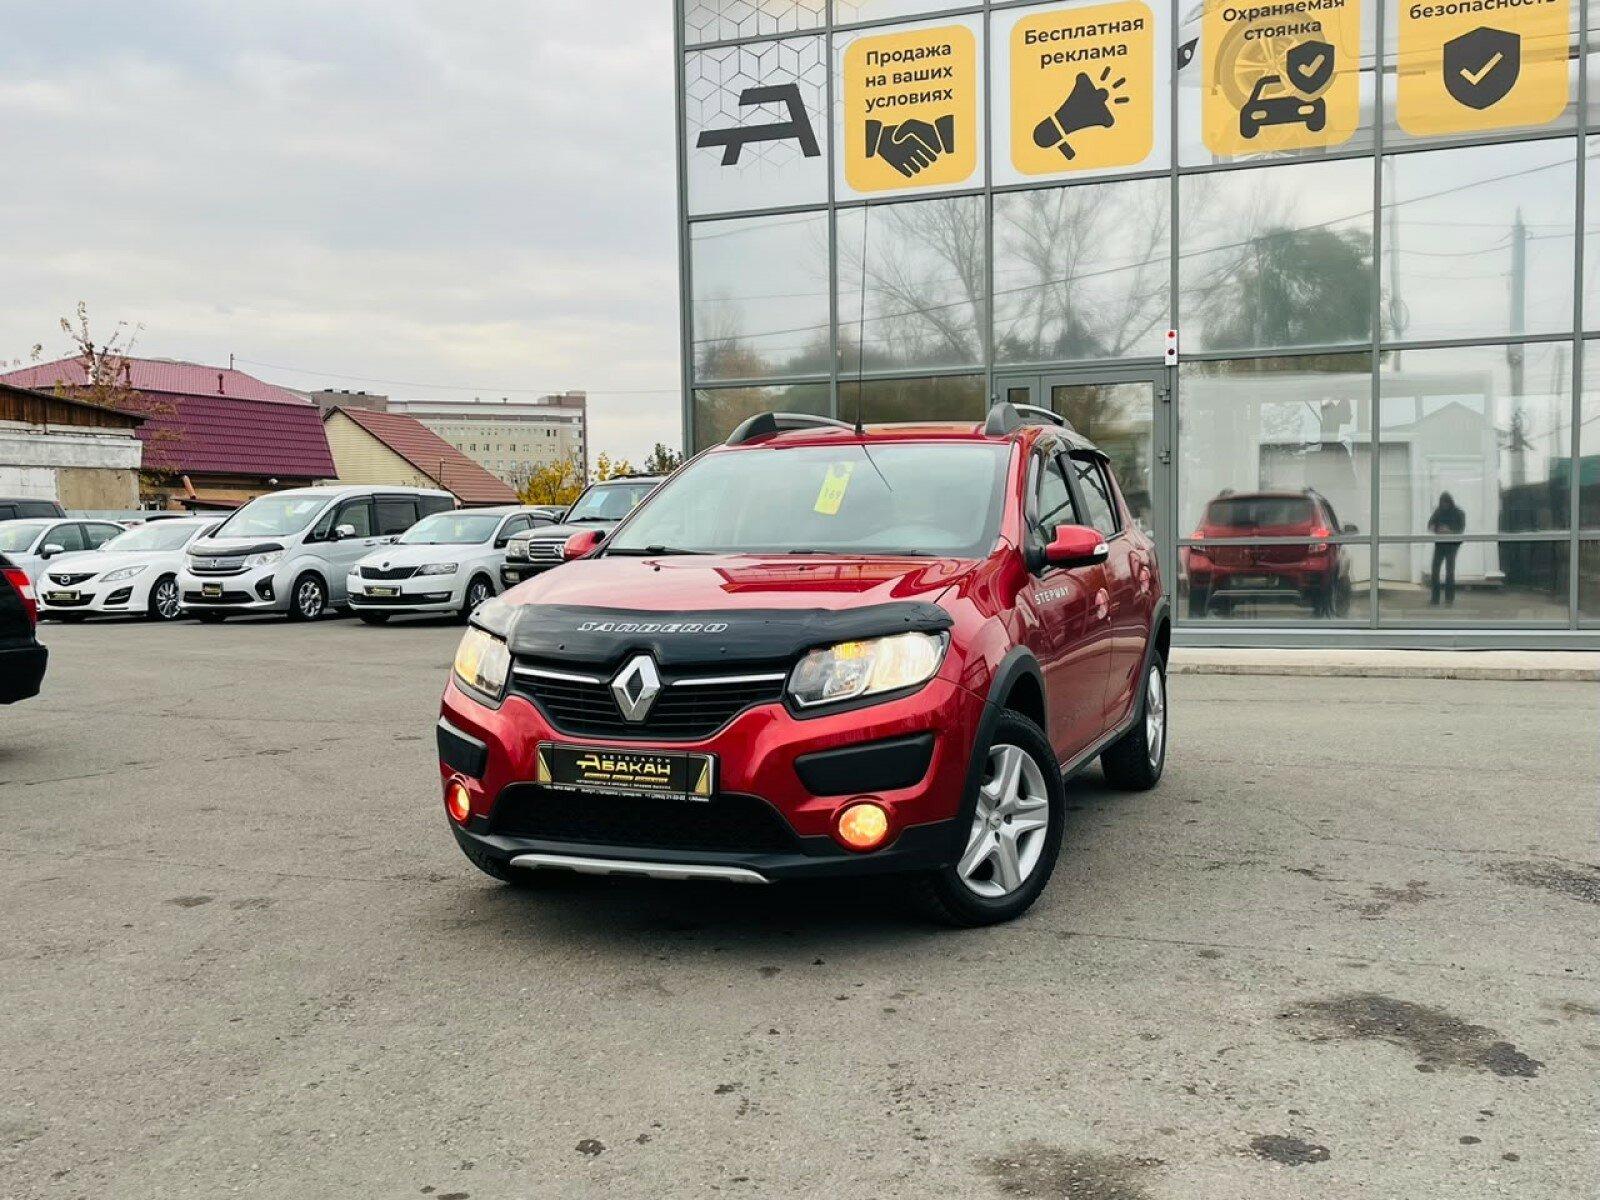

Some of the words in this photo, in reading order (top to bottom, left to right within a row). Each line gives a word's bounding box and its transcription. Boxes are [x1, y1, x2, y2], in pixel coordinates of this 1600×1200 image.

[1222, 0, 1345, 22] Охраняемая
[1409, 0, 1556, 20] безопаснос
[1024, 18, 1144, 45] Бесплатная
[1243, 20, 1322, 41] стоянка
[866, 44, 952, 67] Продажа
[1040, 44, 1128, 70] реклама
[865, 74, 886, 87] на
[893, 66, 953, 84] ваших
[865, 88, 953, 113] условиях
[1034, 586, 1068, 605] STEPWAY
[577, 622, 729, 634] SANDERO
